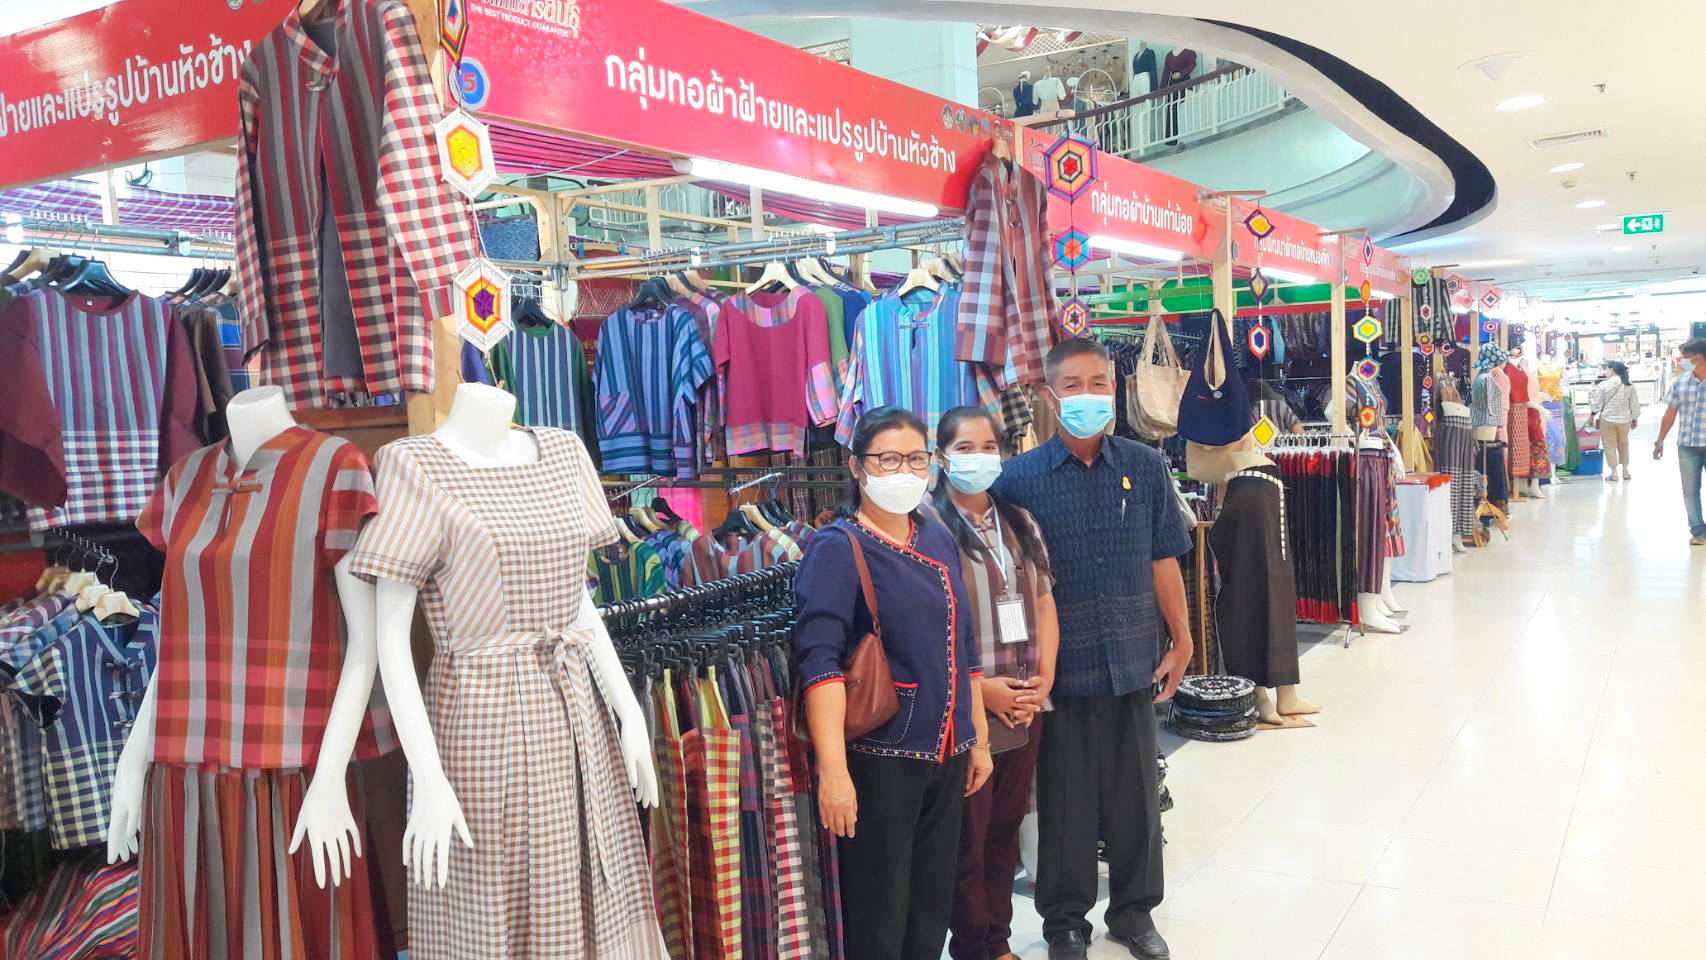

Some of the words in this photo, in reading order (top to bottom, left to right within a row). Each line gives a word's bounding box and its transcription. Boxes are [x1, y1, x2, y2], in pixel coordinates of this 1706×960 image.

[470, 3, 483, 14] THE
[484, 7, 499, 19] BEST
[501, 12, 530, 28] PRODUCT
[463, 72, 477, 92] 5
[604, 46, 957, 174] กลุ่มทอผ้าฝ้ายและแปรรูปบ้านหัวช้าง
